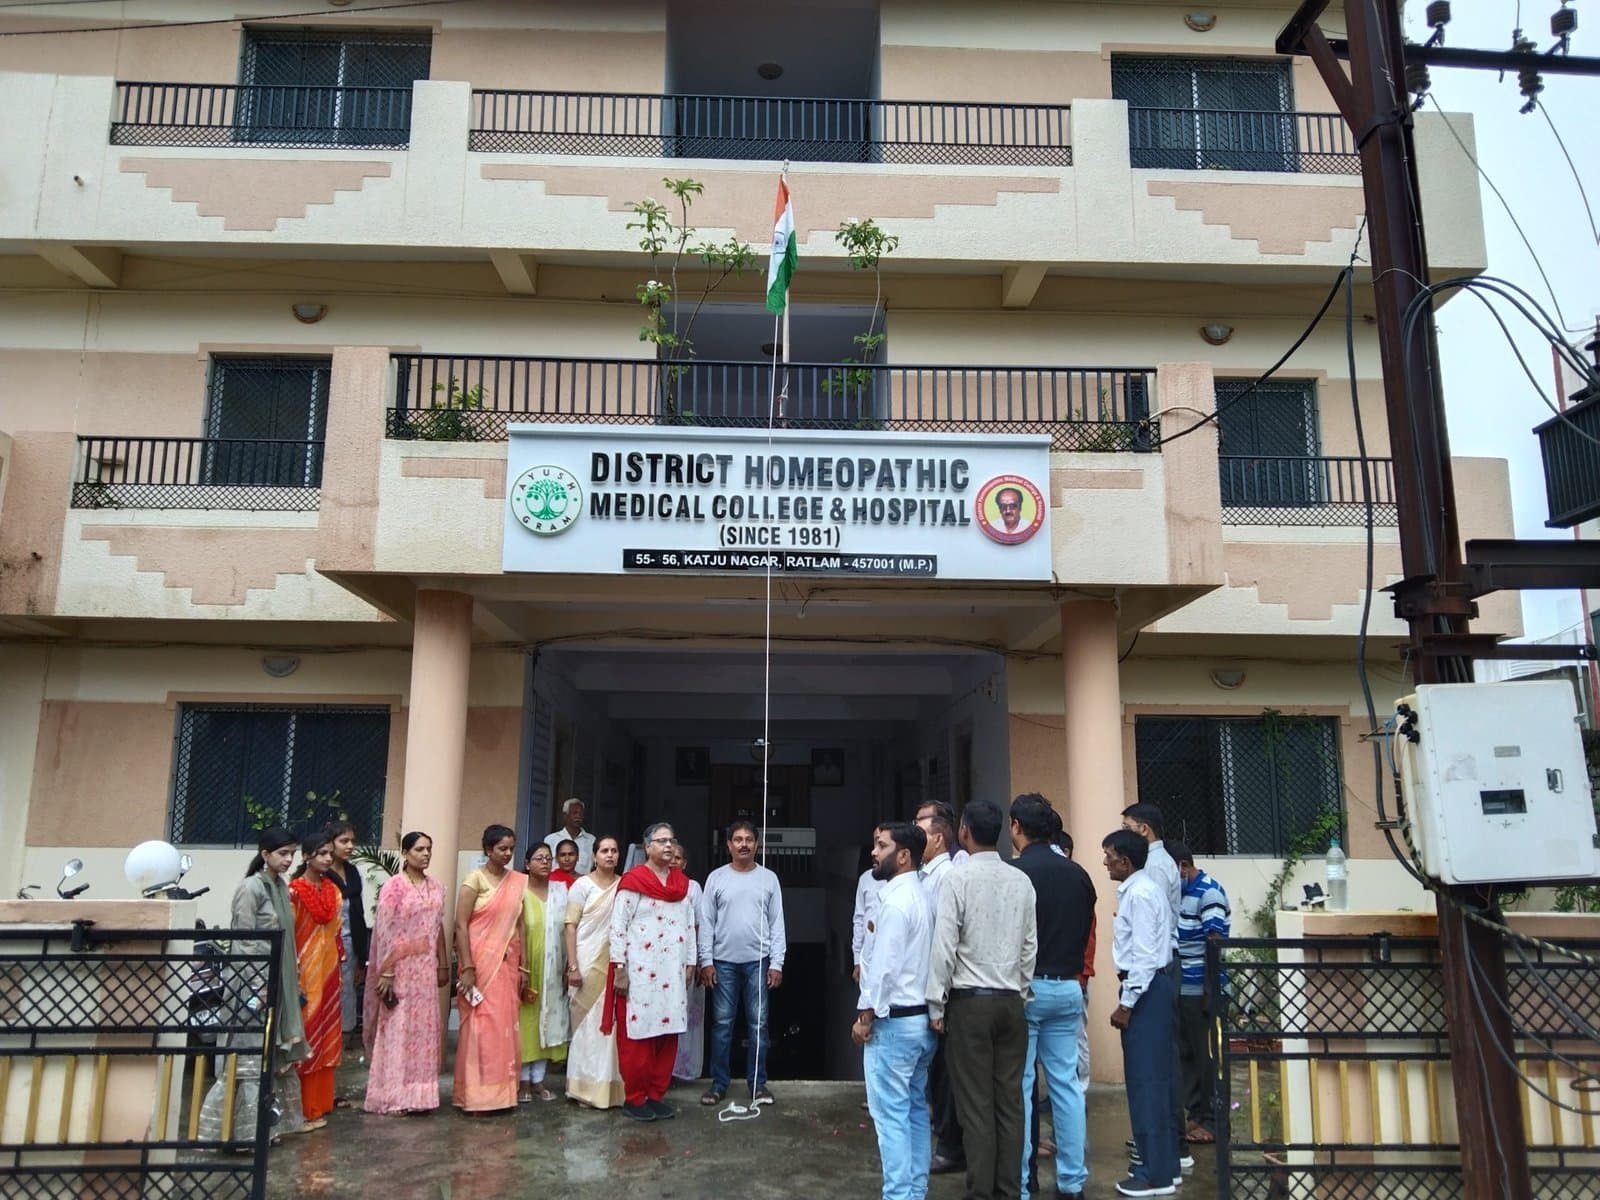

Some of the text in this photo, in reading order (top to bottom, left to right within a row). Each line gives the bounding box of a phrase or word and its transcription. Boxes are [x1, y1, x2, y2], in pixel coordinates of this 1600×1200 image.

[519, 469, 576, 490] AYUSH
[591, 451, 733, 487] DISTRICT
[745, 455, 969, 491] HOMEOPATHIC
[590, 491, 705, 521] MEDICAL
[712, 494, 824, 522] COLLEGE
[829, 497, 847, 523] &
[852, 497, 971, 525] HOSPITAL
[522, 515, 572, 531] GRAM
[720, 524, 841, 548] (SINCE 1981)
[635, 554, 655, 566] 55-
[662, 555, 680, 567] 56,
[684, 555, 728, 567] KATJU
[730, 555, 782, 569] NAGAR,
[786, 556, 841, 569] RATLAM
[852, 557, 895, 569] 457001
[898, 557, 933, 572] (M.P.)
